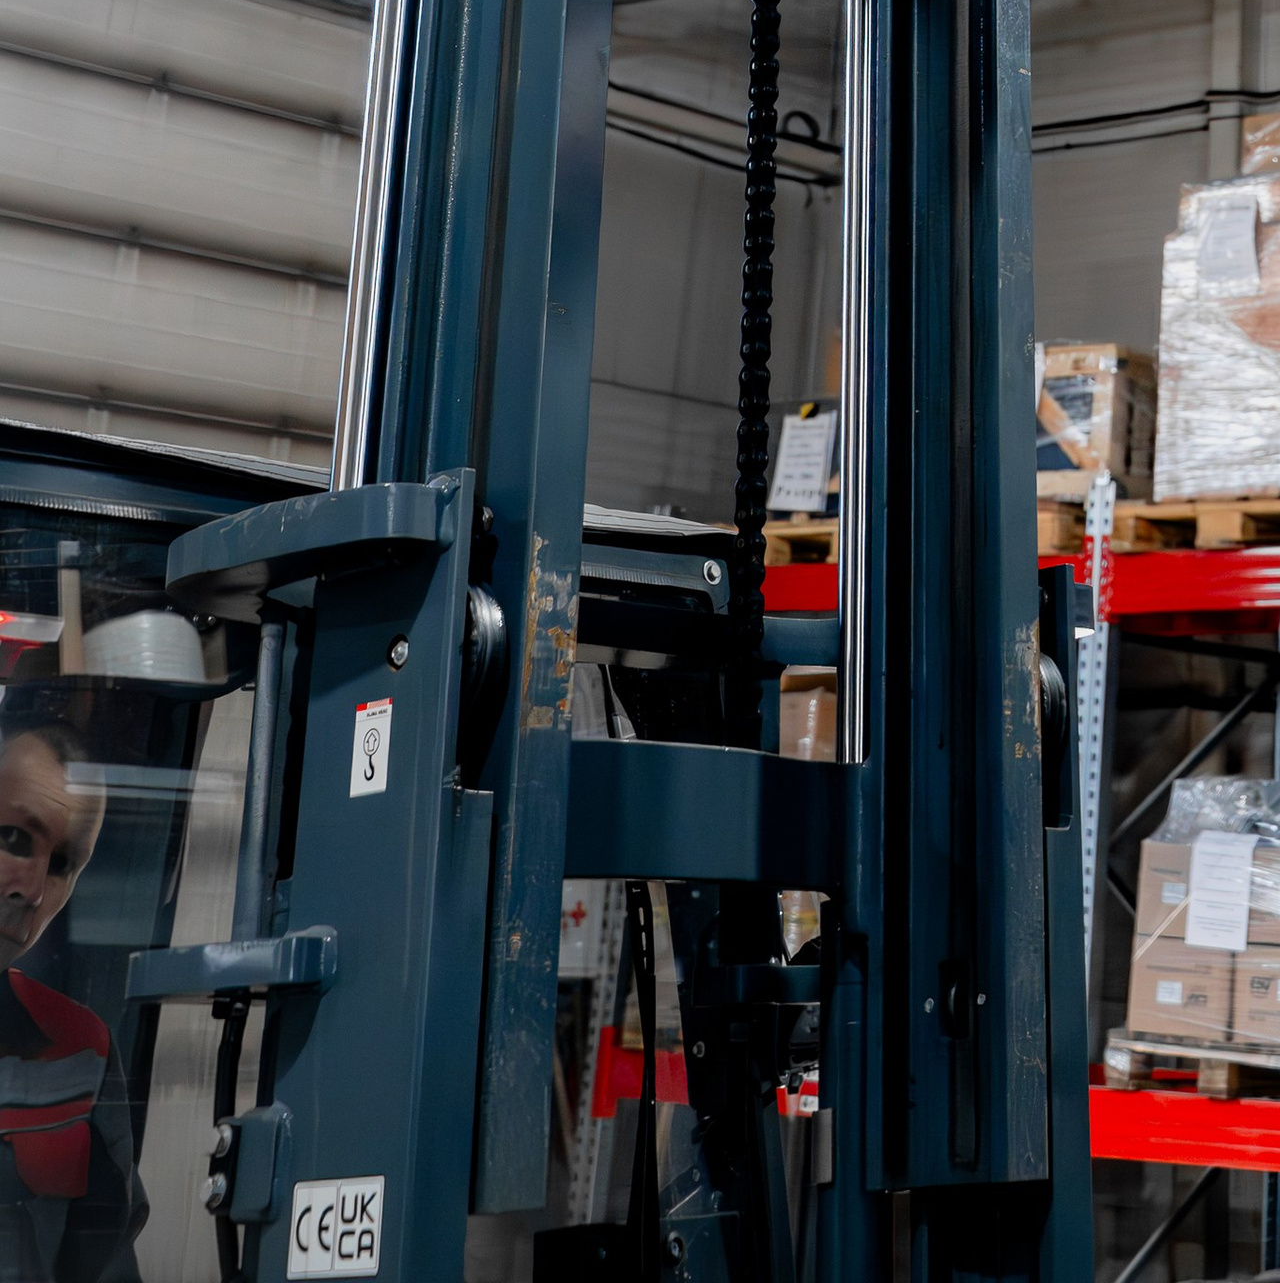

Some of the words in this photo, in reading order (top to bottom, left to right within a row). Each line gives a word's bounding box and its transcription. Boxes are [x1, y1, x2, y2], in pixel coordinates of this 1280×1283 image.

[341, 1192, 377, 1224] UK
[296, 1204, 334, 1252] CE
[338, 1229, 374, 1260] CA
